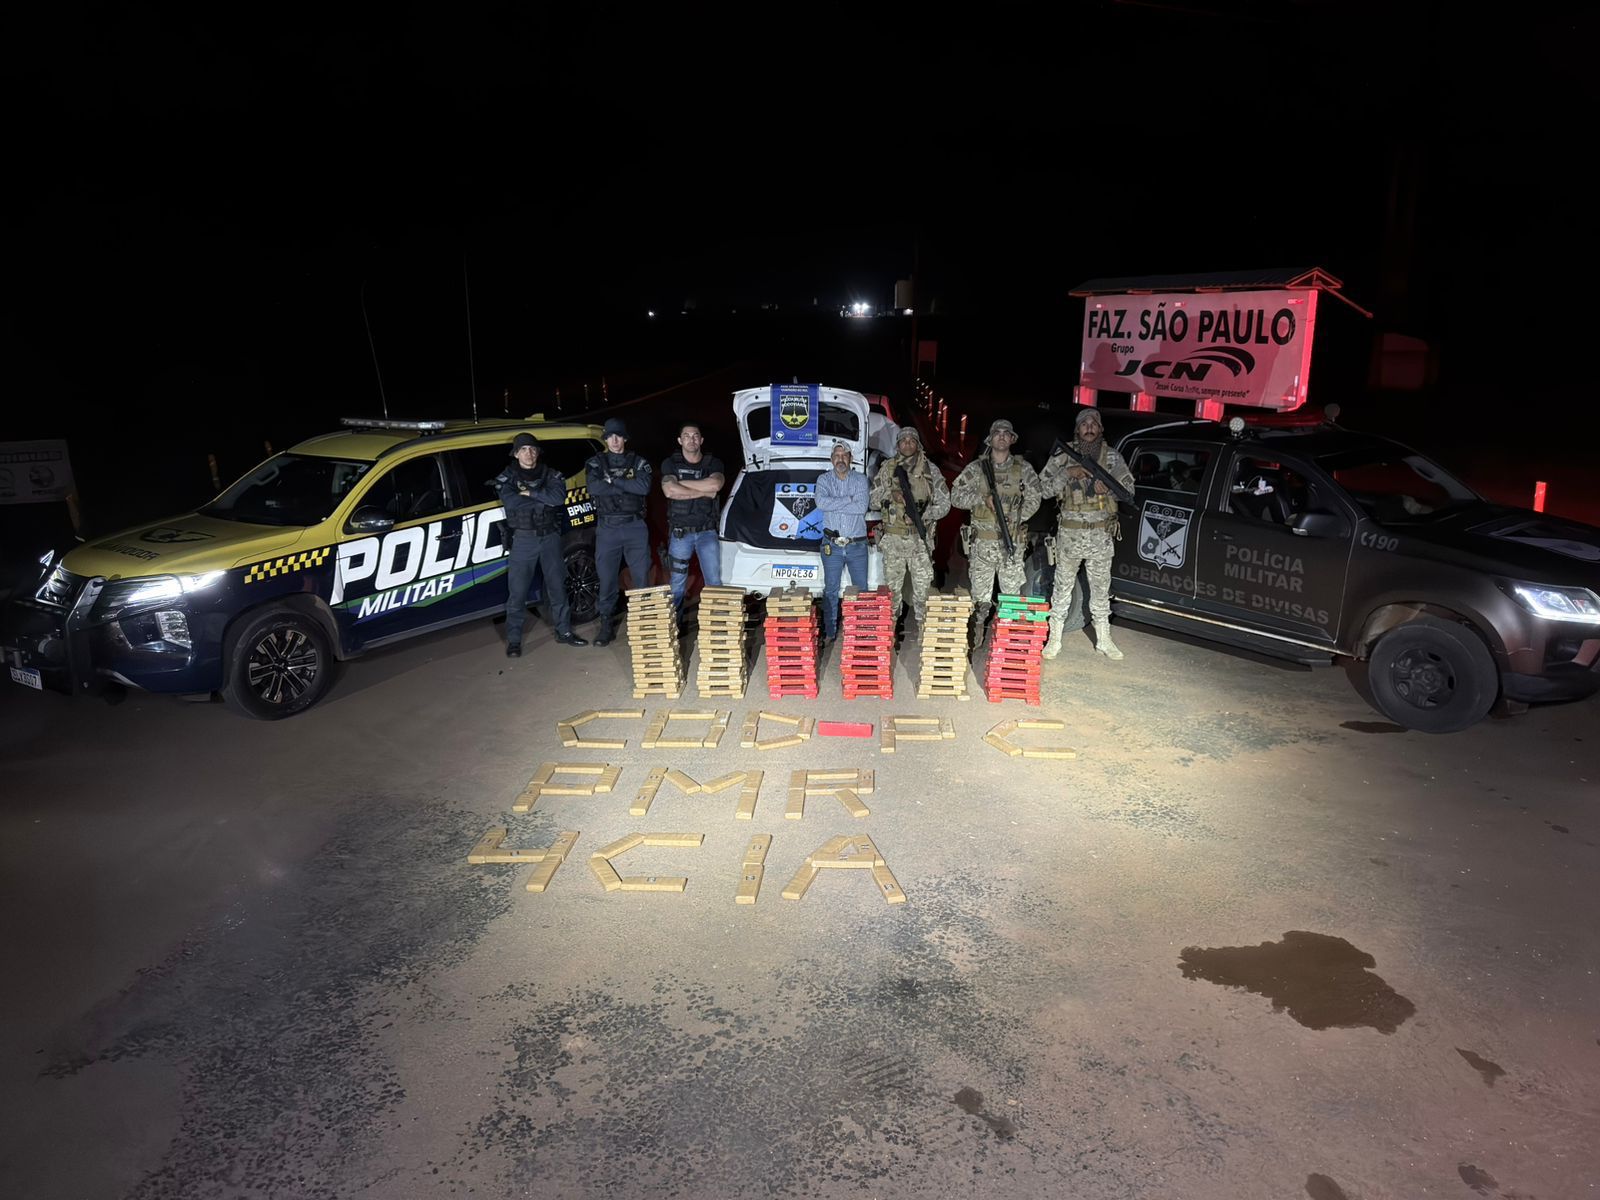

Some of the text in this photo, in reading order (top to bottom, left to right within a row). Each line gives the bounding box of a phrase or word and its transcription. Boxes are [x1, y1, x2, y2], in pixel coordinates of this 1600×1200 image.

[1088, 303, 1296, 346] FAZ. SÃO PAULO
[1111, 343, 1135, 354] Grupo
[1114, 360, 1212, 381] JCN
[330, 506, 510, 606] POLIC
[1369, 533, 1399, 551] 190
[1226, 545, 1305, 575] POLÍCIA
[1224, 563, 1304, 593] MILITAR
[358, 574, 455, 619] MILITAR
[1118, 563, 1330, 625] OPERAÇÕES DE DIVISAS
